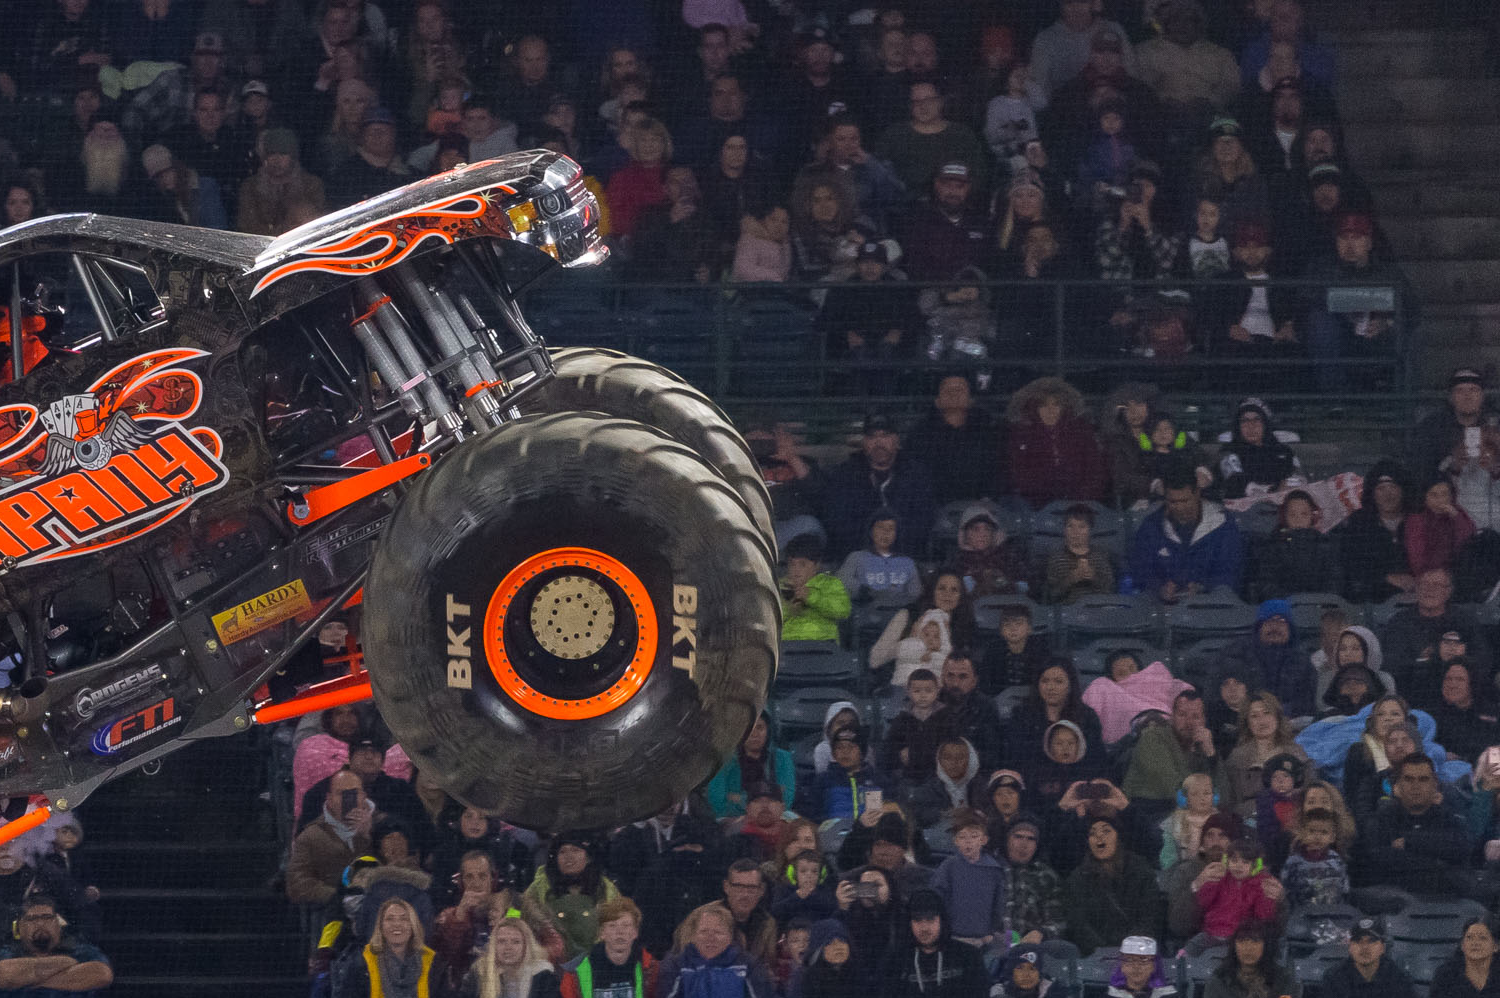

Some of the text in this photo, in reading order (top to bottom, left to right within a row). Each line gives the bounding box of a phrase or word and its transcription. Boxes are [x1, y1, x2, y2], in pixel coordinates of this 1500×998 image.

[241, 581, 300, 616] HARDY
[672, 584, 698, 679] BKT
[447, 593, 472, 689] BKT
[109, 697, 175, 747] FTI
